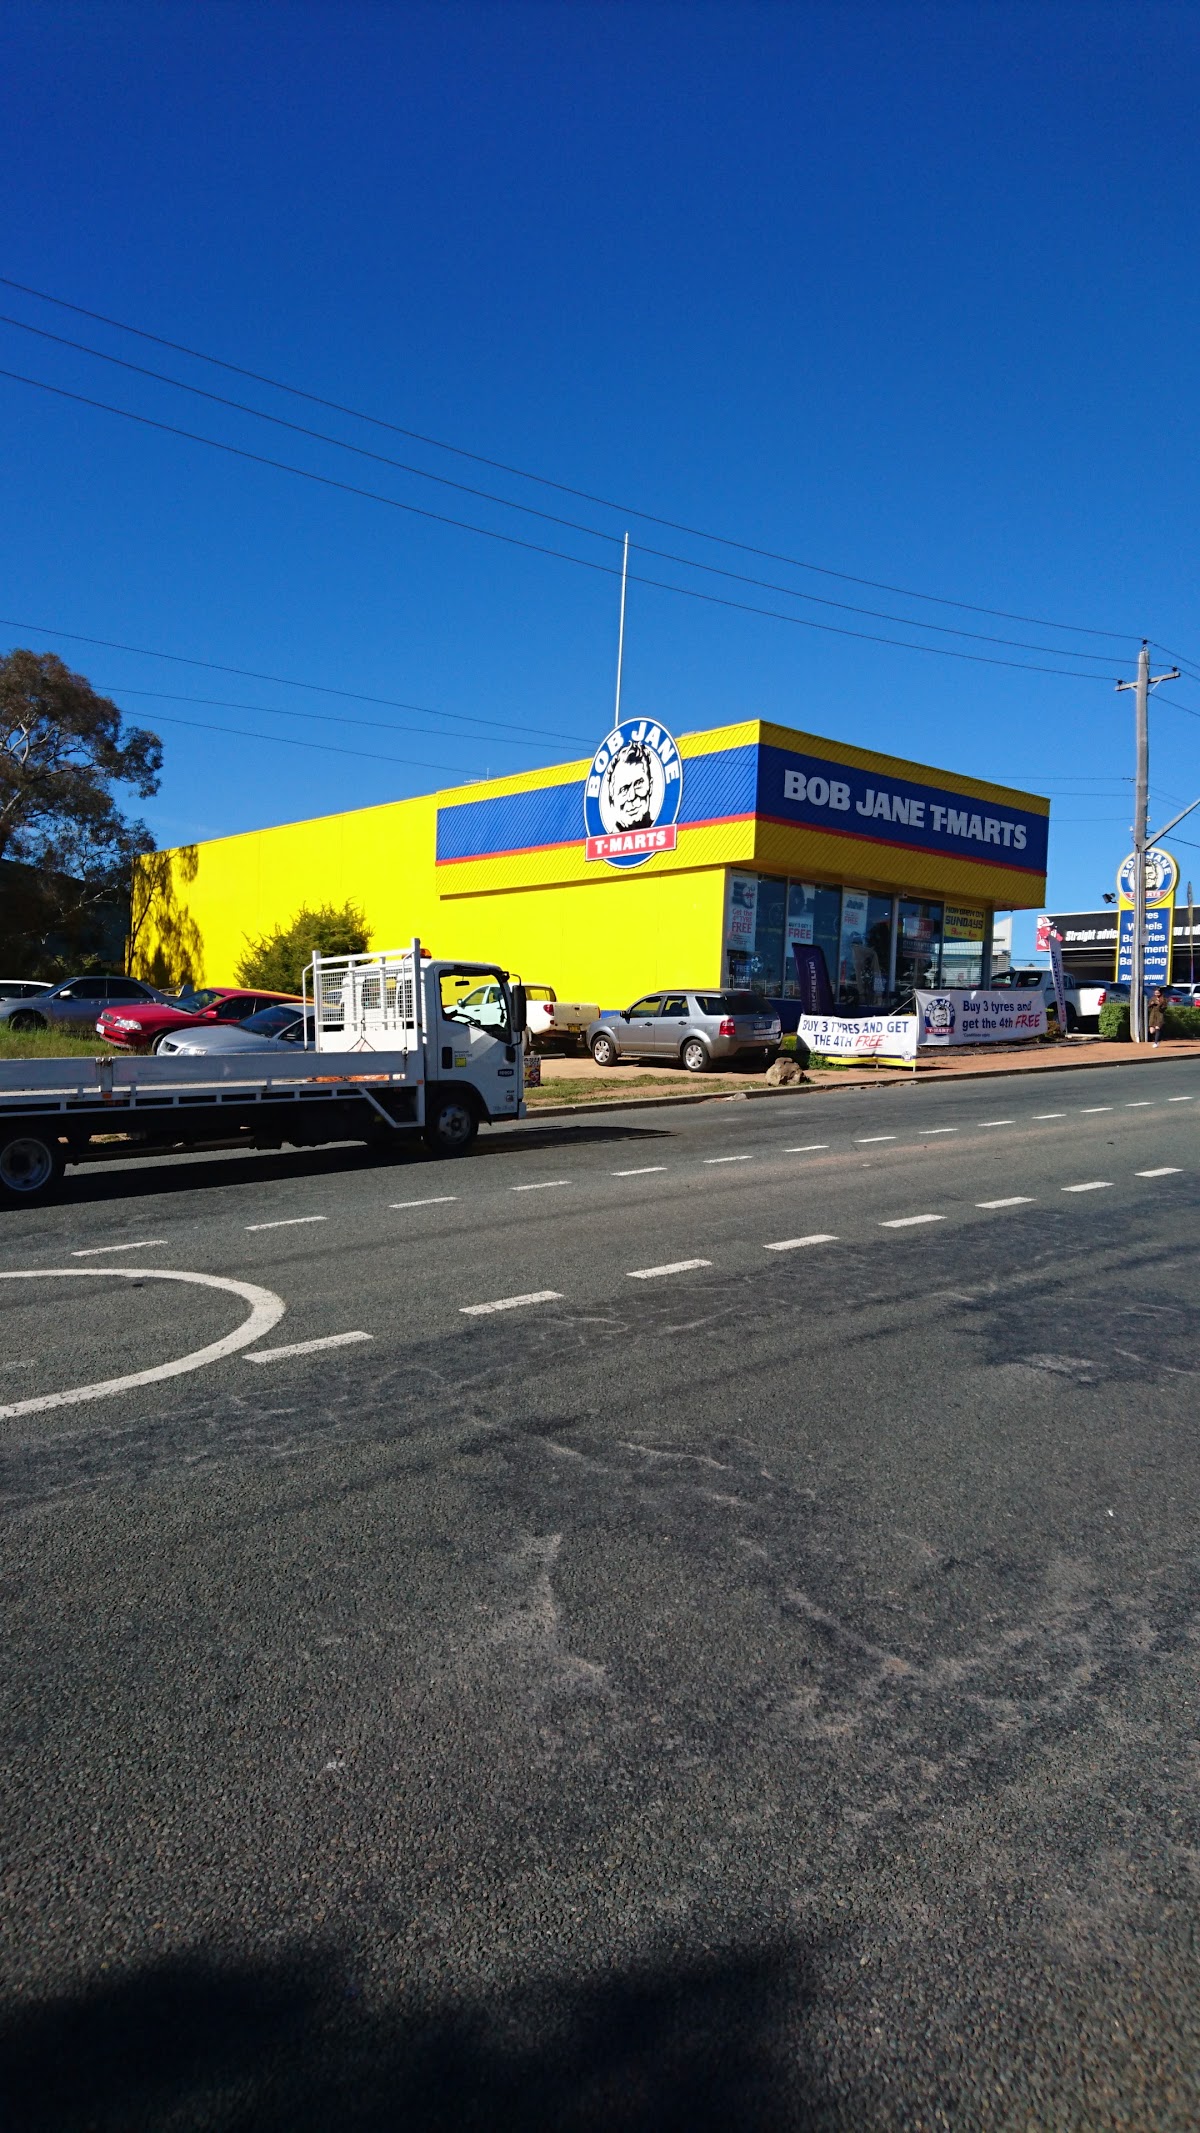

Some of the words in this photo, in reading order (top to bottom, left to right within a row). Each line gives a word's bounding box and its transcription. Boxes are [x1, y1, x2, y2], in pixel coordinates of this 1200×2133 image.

[587, 731, 624, 798] BOB
[631, 721, 680, 784] JANE
[783, 769, 851, 811] BOB
[856, 789, 925, 828] JANE
[929, 804, 1027, 850] T-MARTS
[1121, 858, 1135, 878] BO
[1146, 853, 1172, 875] JANE
[732, 921, 752, 934] FREE
[945, 915, 983, 929] SUNDAYS
[788, 928, 811, 939] FREE
[1065, 929, 1096, 942] Straight
[1119, 945, 1168, 954] Aliment
[963, 1000, 981, 1014] Buy
[983, 1000, 989, 1011] 3
[991, 1001, 1014, 1014] tyres
[1017, 1001, 1032, 1011] and
[802, 1019, 819, 1032] BUY
[821, 1021, 828, 1032] 3
[831, 1021, 860, 1034] TYRES
[862, 1021, 883, 1033] AND
[887, 1021, 909, 1033] GET
[962, 1018, 979, 1031] get
[982, 1017, 997, 1029] the
[999, 1017, 1013, 1028] 4th
[813, 1034, 831, 1046] THE
[833, 1035, 853, 1047] 4TH
